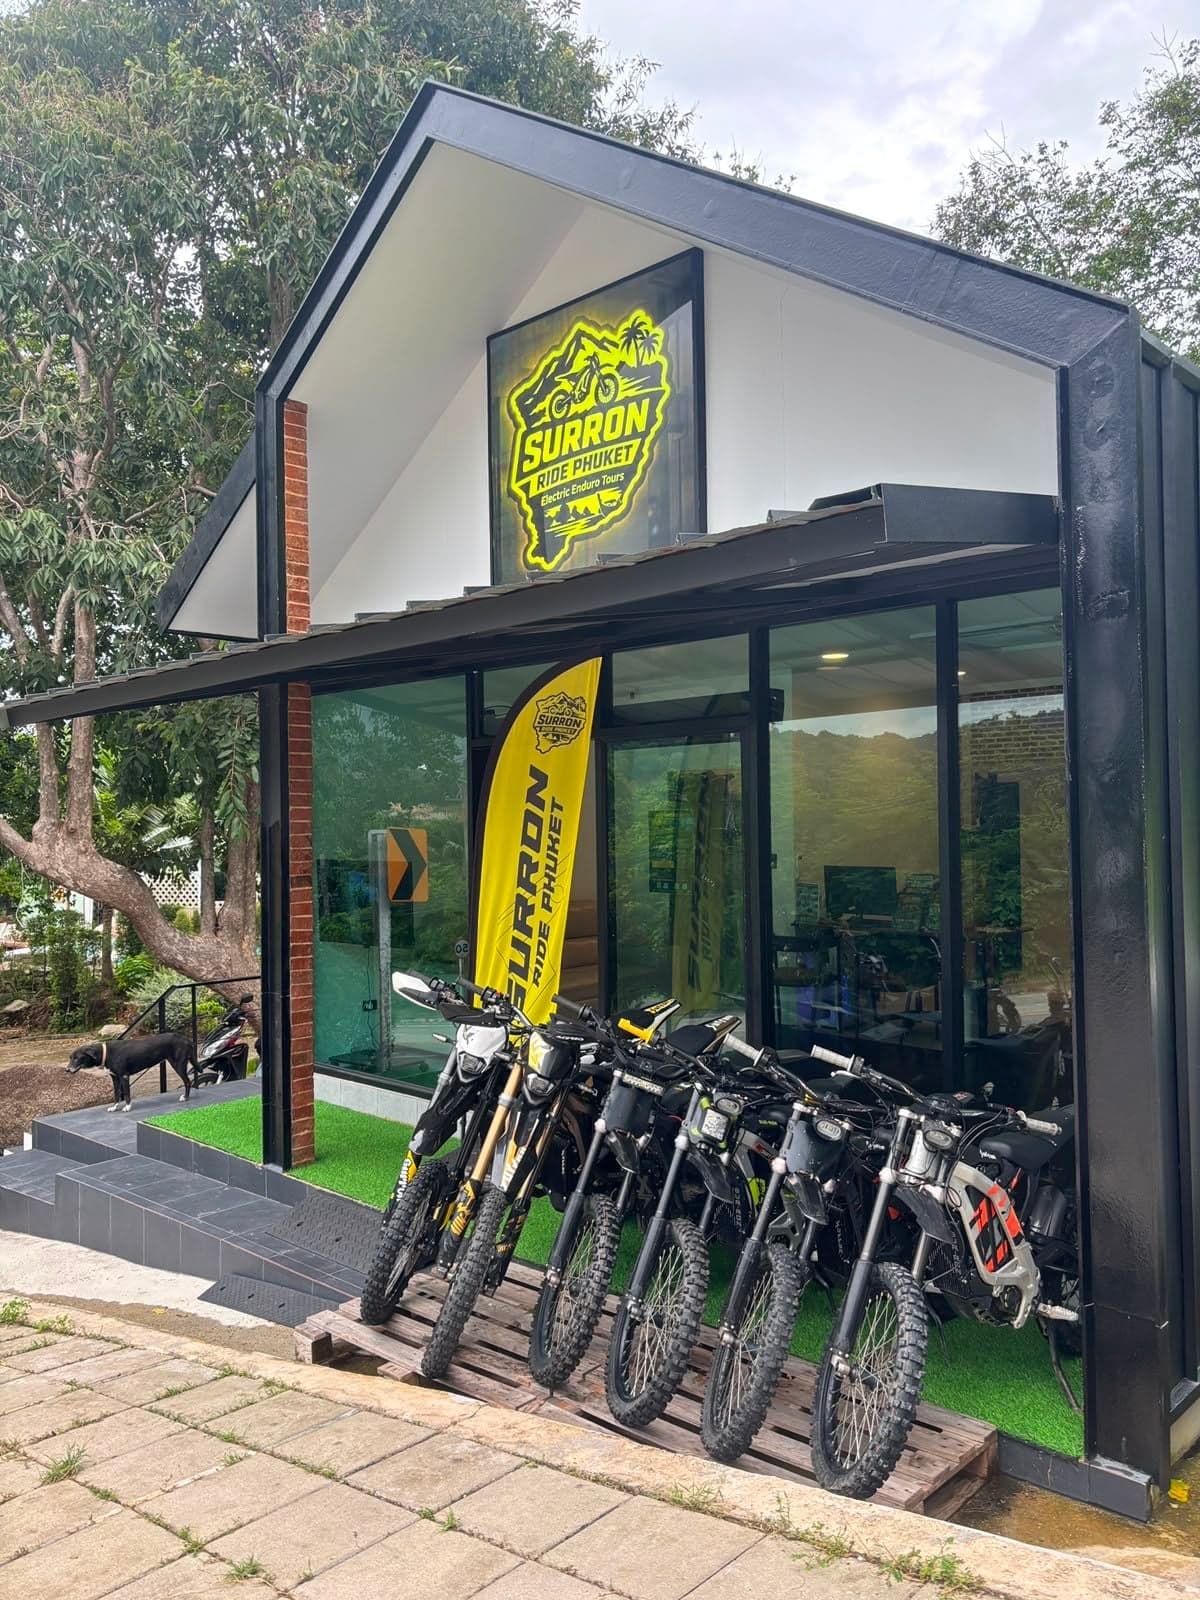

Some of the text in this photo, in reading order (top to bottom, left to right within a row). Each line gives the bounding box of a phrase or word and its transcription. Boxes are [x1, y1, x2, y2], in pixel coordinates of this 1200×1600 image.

[522, 397, 650, 472] SURRON
[537, 443, 634, 489] RIDE PHUKET
[541, 472, 625, 507] Electric Enduro Tours
[538, 714, 582, 728] SURRON
[507, 763, 549, 1010] SURRON
[533, 796, 563, 988] RIDE PHUKET
